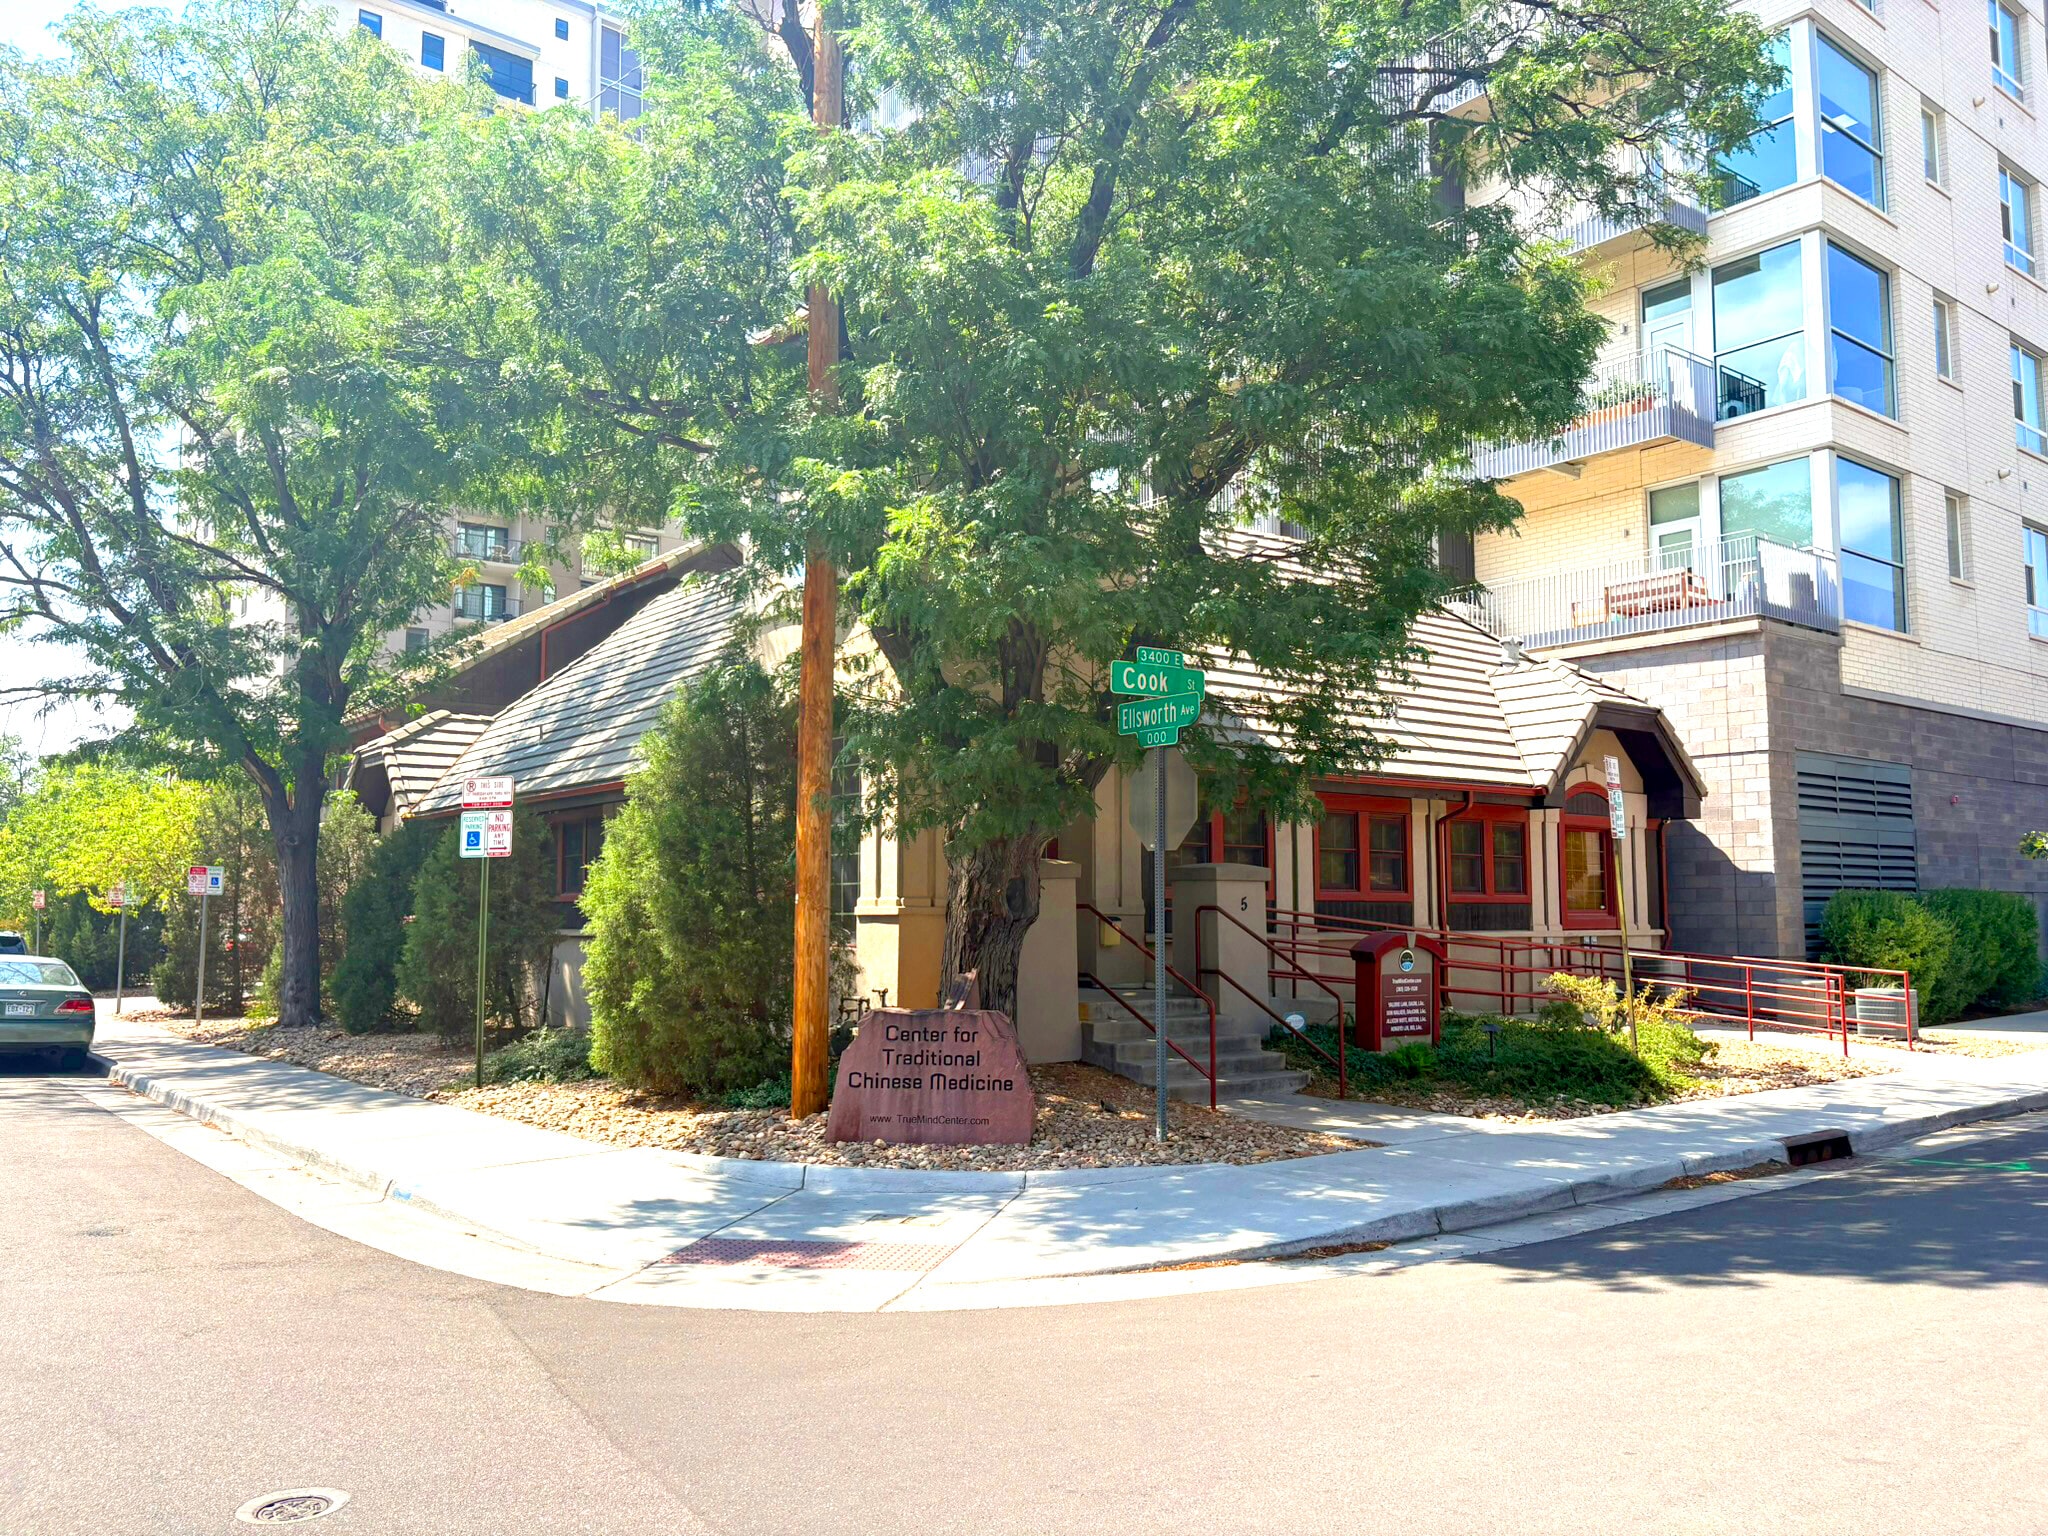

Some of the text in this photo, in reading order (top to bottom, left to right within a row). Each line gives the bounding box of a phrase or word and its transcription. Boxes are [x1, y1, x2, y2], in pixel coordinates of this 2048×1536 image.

[1140, 650, 1181, 665] 3400 E
[1123, 667, 1195, 692] Cook St
[1122, 701, 1195, 730] Ellsworth Ave
[1147, 731, 1167, 744] 000
[495, 814, 504, 822] NO
[488, 823, 511, 832] PARKING
[1241, 896, 1248, 911] 5
[885, 1025, 978, 1043] Center for
[882, 1049, 980, 1066] Traditional
[848, 1072, 1014, 1091] Chinese Medicine
